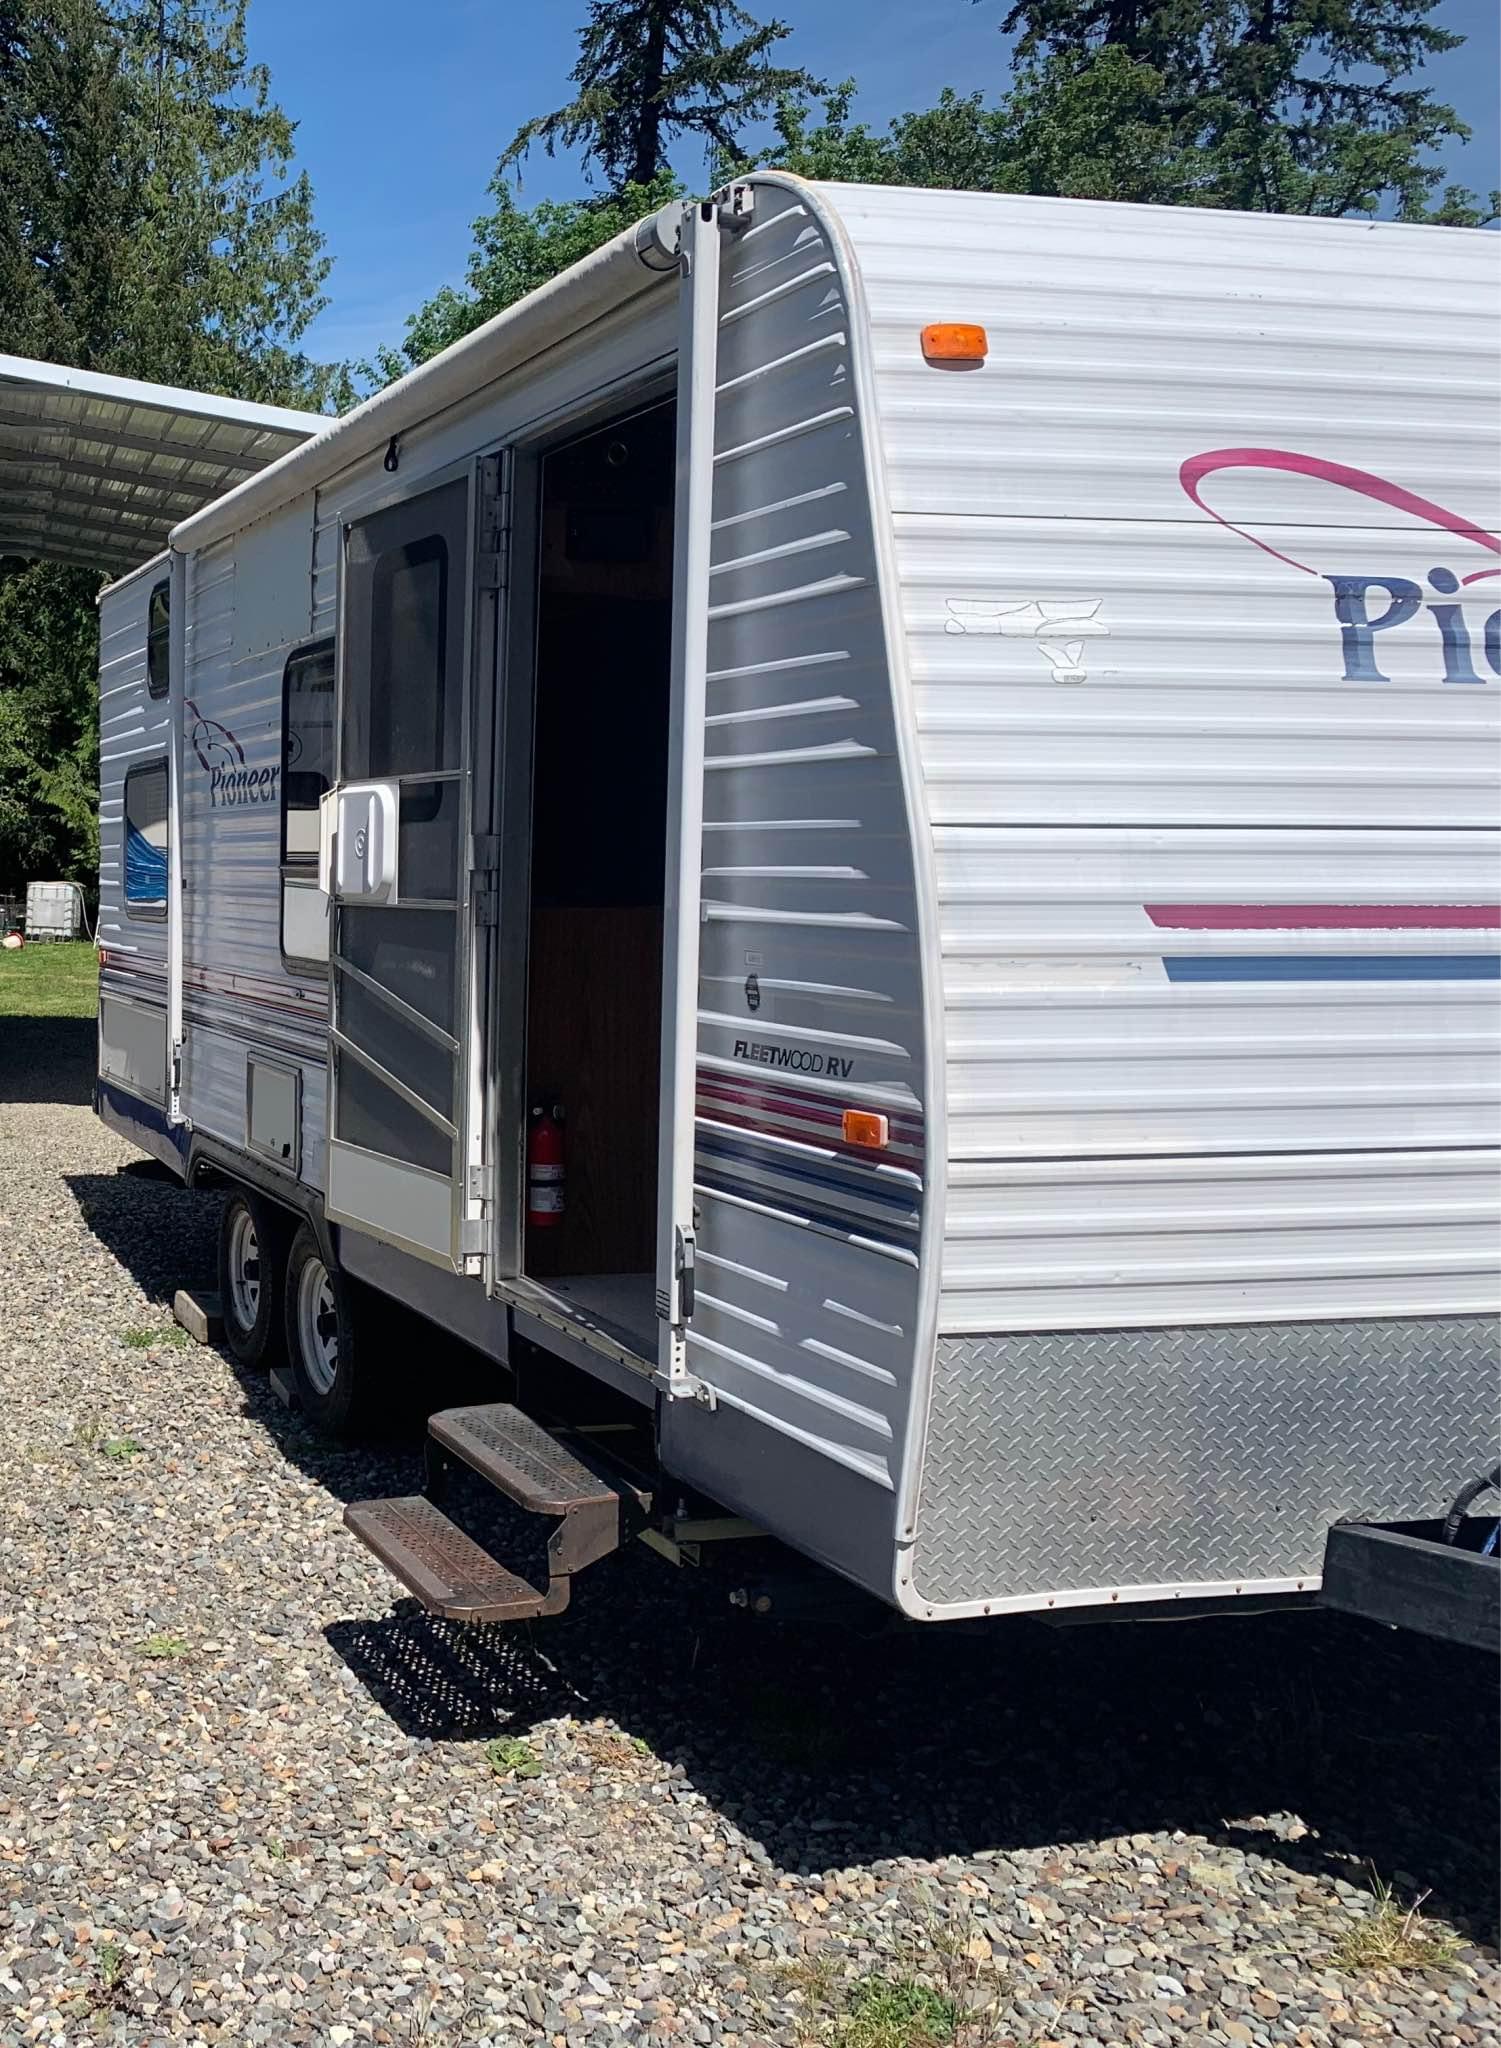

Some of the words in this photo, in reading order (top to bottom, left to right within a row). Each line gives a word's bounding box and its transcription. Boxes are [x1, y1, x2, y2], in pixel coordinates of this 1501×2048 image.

[1321, 567, 1501, 684] Pi
[210, 761, 281, 808] Pioneer
[733, 1040, 824, 1072] FLEETWOOD
[826, 1056, 855, 1078] RV
